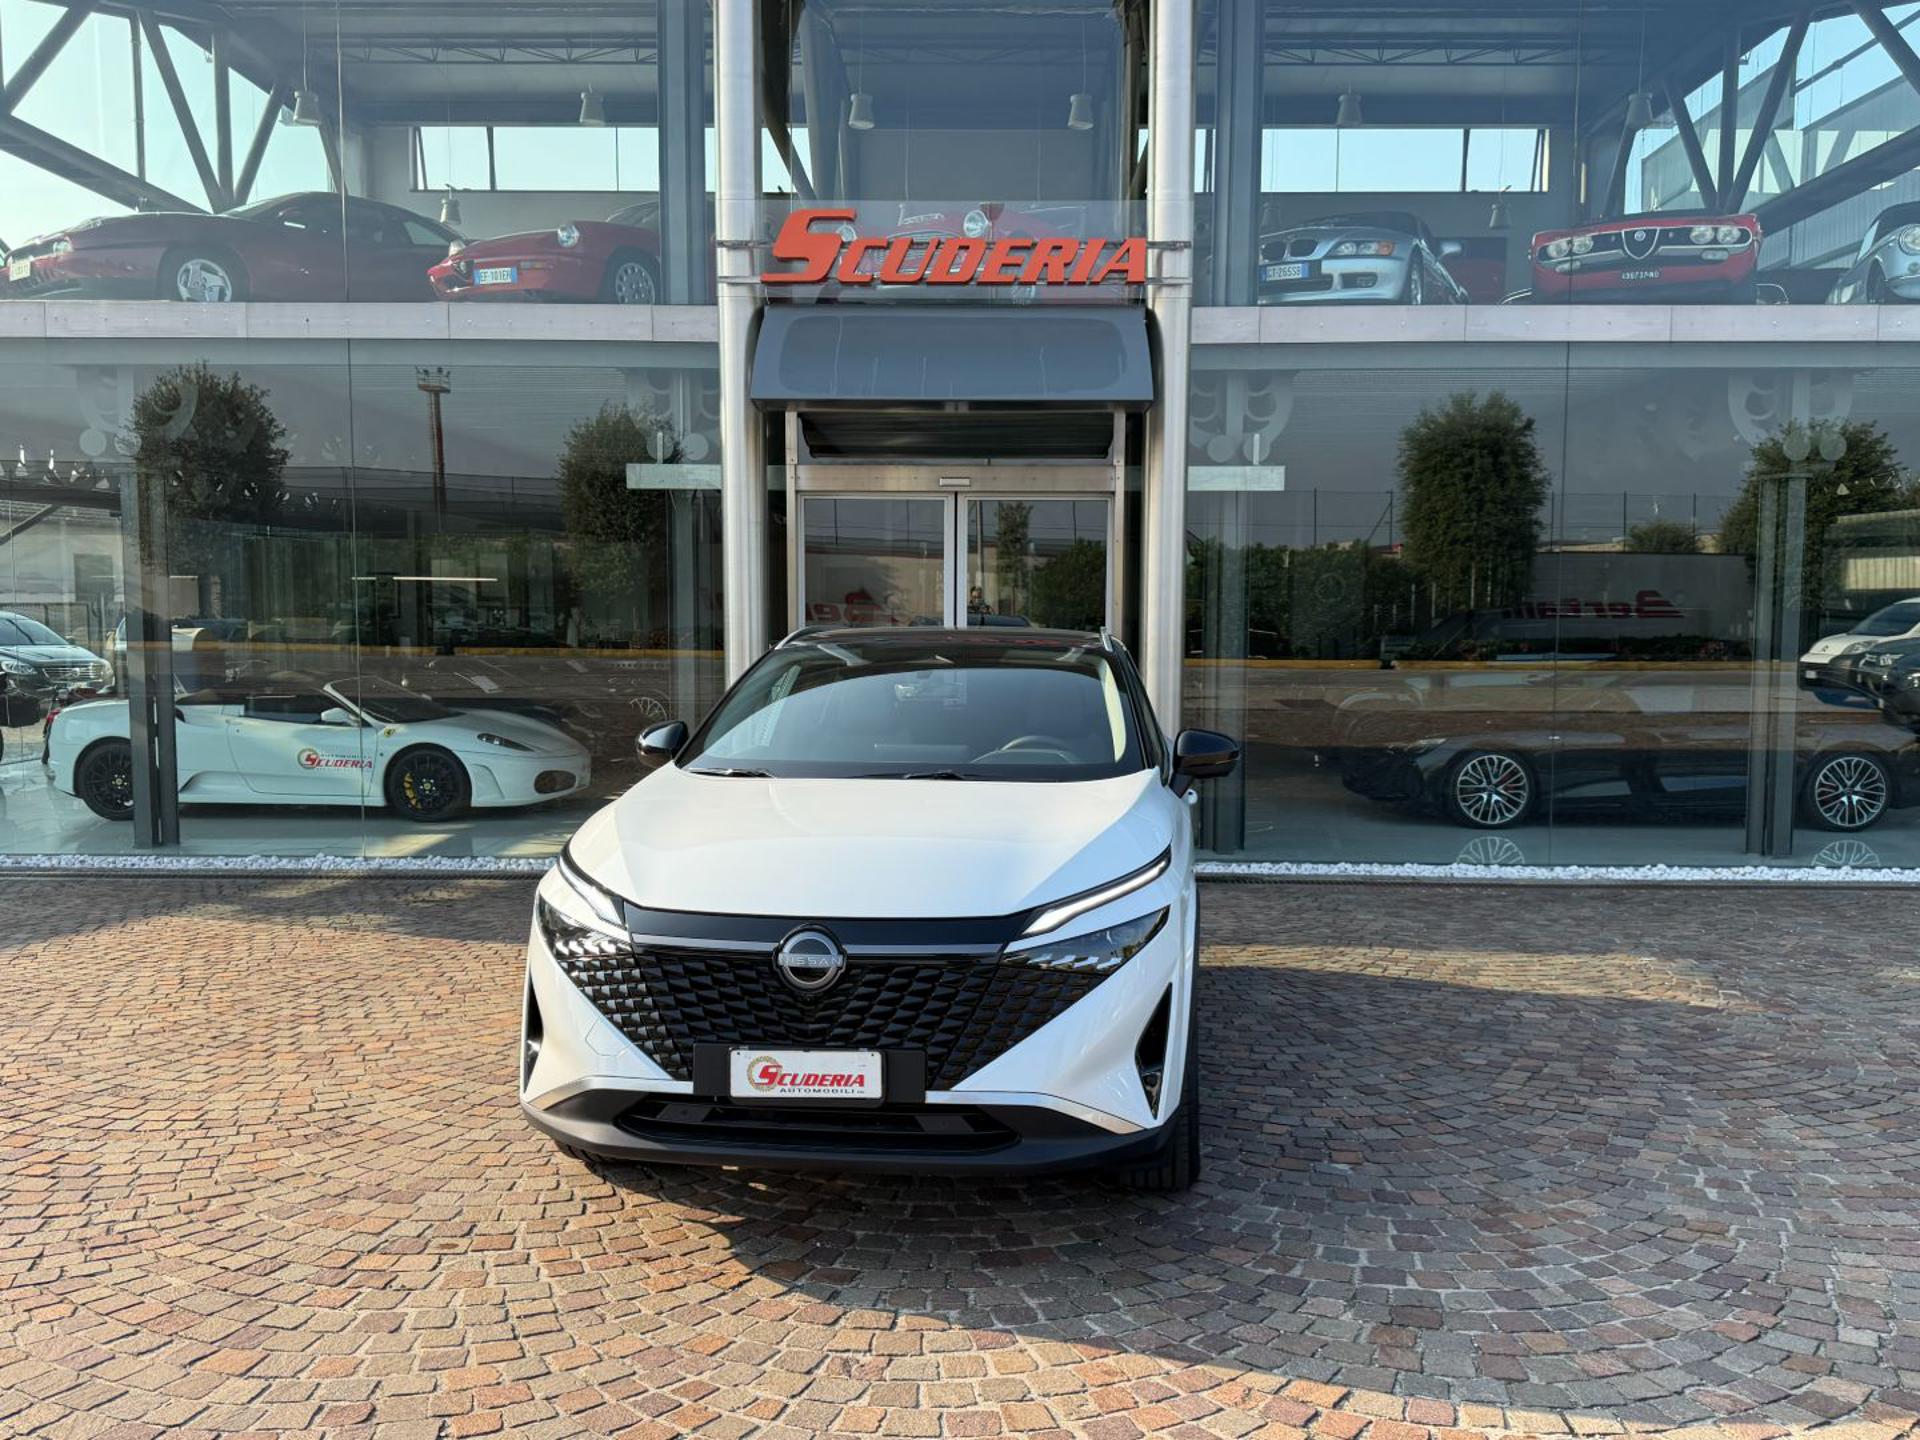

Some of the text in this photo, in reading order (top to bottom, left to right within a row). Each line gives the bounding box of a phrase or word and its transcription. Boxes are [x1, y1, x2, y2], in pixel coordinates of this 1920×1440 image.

[760, 208, 1147, 285] SCUDERIA
[305, 754, 373, 768] SCUDERIA
[780, 956, 842, 966] NISSAN
[754, 1065, 865, 1087] SCUDERIA
